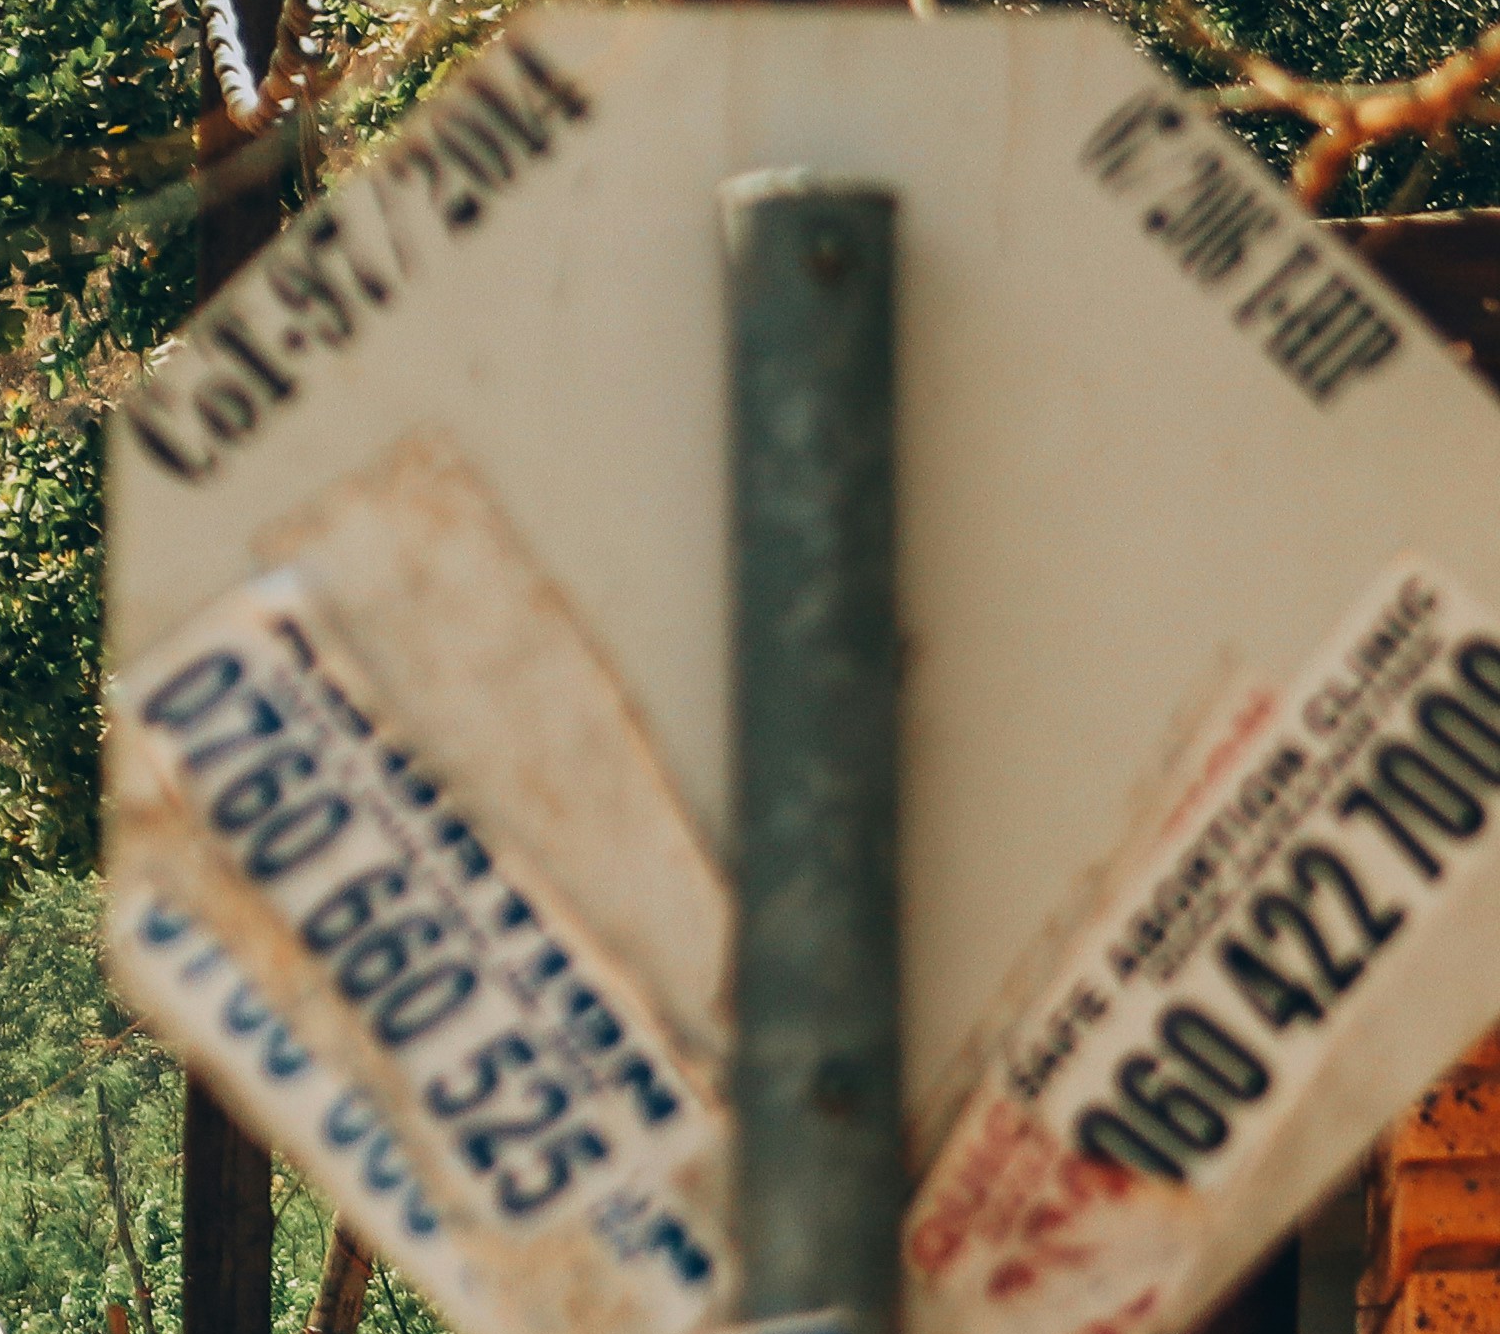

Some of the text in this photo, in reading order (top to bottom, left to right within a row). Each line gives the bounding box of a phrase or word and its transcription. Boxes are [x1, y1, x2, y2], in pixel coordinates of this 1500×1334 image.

[141, 651, 352, 883] 0760
[299, 868, 478, 1049] 660
[425, 1033, 610, 1217] 525
[1110, 745, 1307, 985] ABORTION
[1303, 575, 1440, 739] CLINIC
[1217, 844, 1404, 1029] 422
